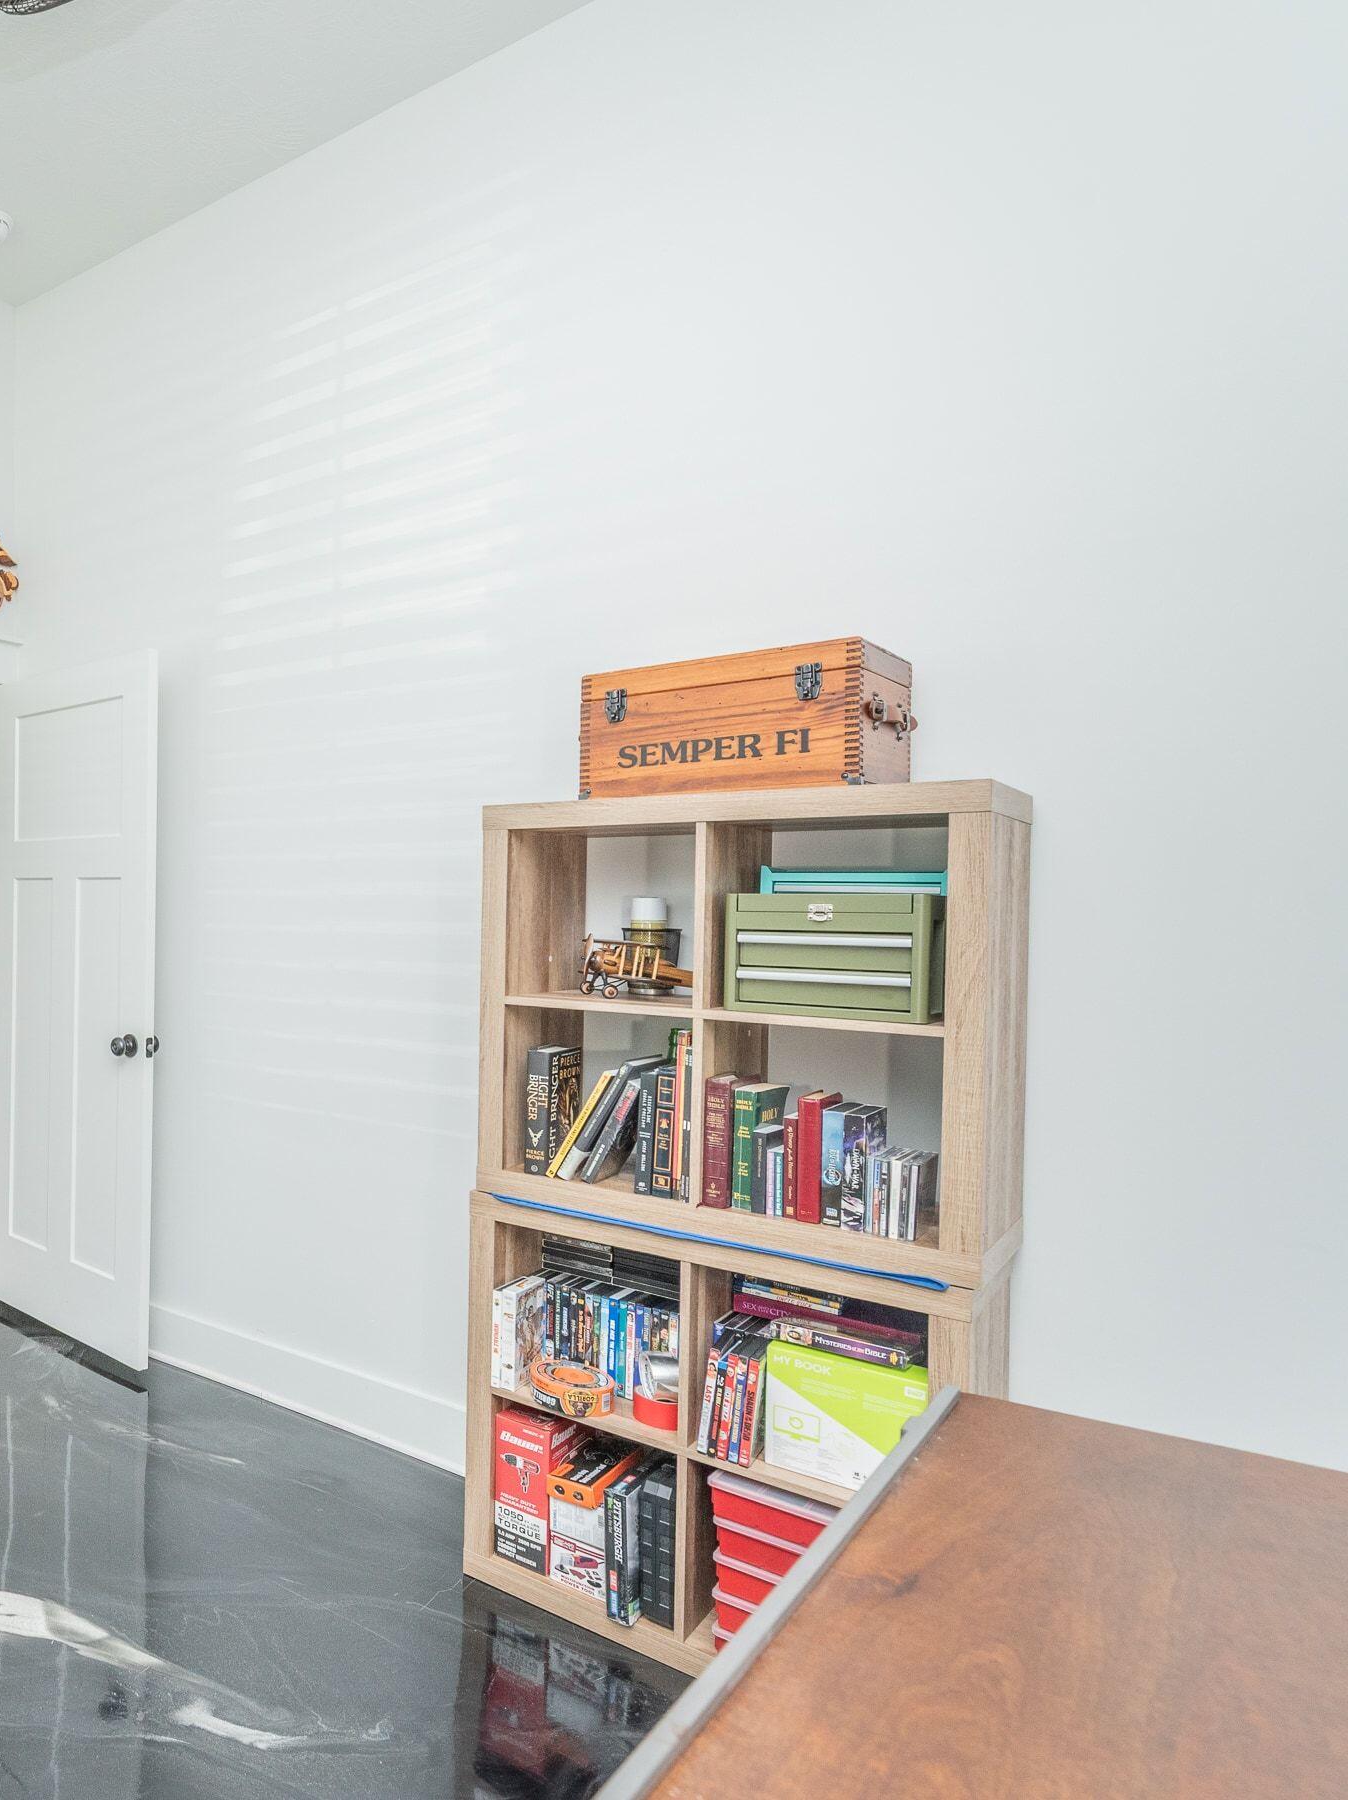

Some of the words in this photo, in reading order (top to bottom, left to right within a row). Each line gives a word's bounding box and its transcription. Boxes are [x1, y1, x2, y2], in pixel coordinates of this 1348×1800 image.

[617, 733, 763, 769] SEMPER
[775, 727, 812, 756] FI
[560, 1053, 581, 1067] PIERCE
[559, 1066, 581, 1080] BROWN
[527, 1073, 539, 1121] BRINGER
[538, 1076, 549, 1109] LIGHT
[550, 1055, 560, 1121] BRINGER
[707, 1096, 725, 1104] HOLY
[761, 1108, 778, 1122] HOLY
[526, 1148, 545, 1157] PIERCE
[548, 1127, 557, 1164] IGHT
[526, 1153, 545, 1161] BROWN
[852, 1148, 860, 1170] DAWN
[852, 1173, 860, 1189] WAR
[547, 1283, 555, 1301] UFC
[742, 1302, 757, 1311] SEX
[769, 1308, 791, 1318] CITY
[815, 1335, 852, 1350] MYSTERIES
[864, 1347, 887, 1359] BIBLE
[773, 1354, 791, 1367] MY
[794, 1358, 832, 1376] BOOK
[567, 1393, 595, 1403] GORILLA
[705, 1385, 713, 1403] LAST
[745, 1390, 755, 1416] SHAUN
[551, 1424, 577, 1450] Bauer
[742, 1421, 752, 1441] DEAD
[500, 1430, 544, 1455] Bauer
[500, 1491, 519, 1501] HEAVY
[520, 1499, 537, 1508] DUTY
[498, 1506, 524, 1522] 1050
[498, 1517, 541, 1541] TORQUE
[613, 1497, 623, 1565] PITTSBURGH
[561, 1578, 579, 1589] POWER
[580, 1586, 595, 1596] TOOL
